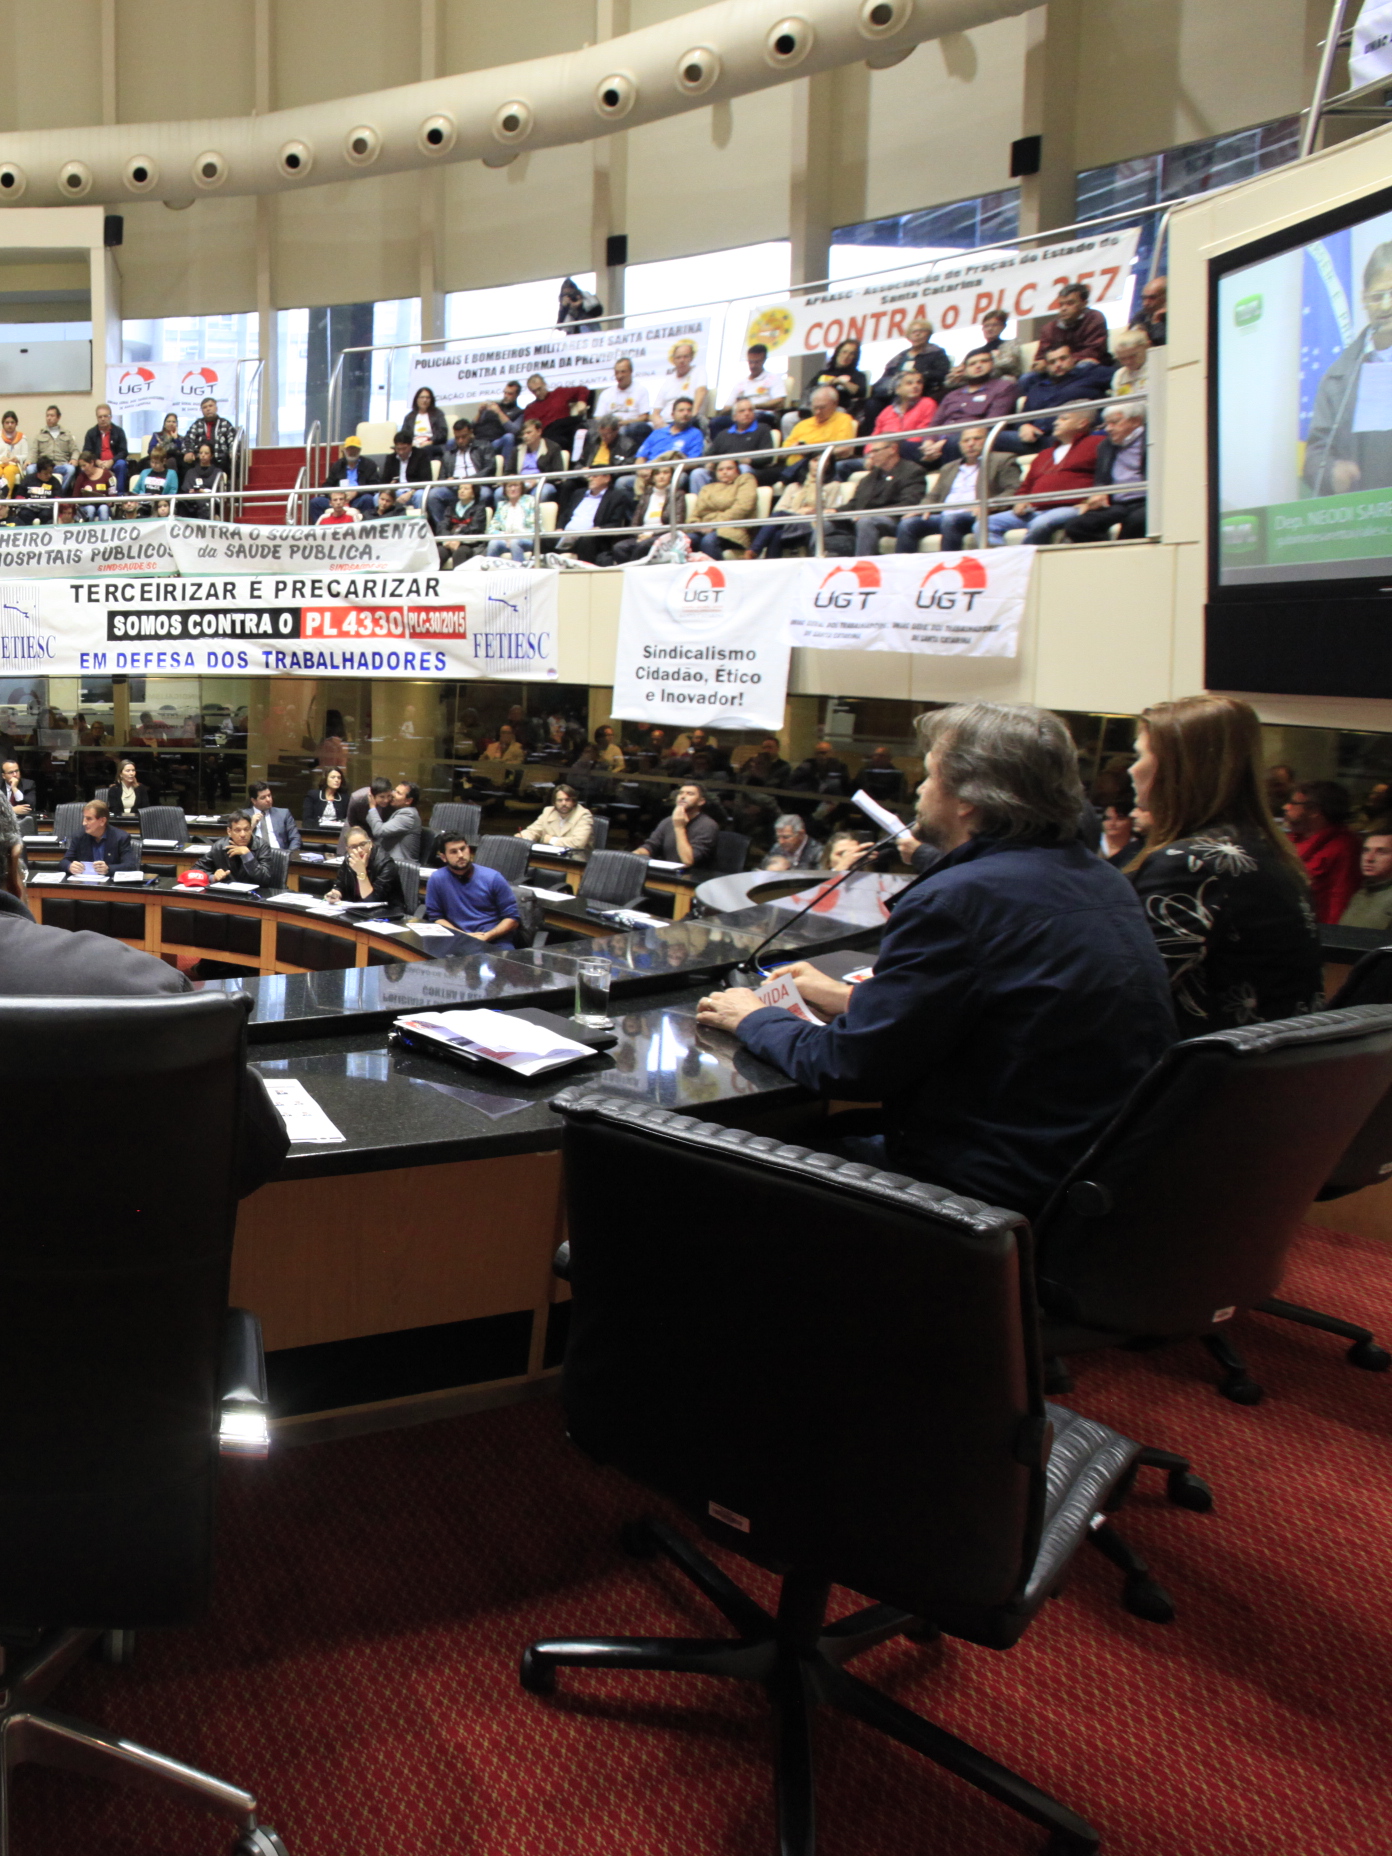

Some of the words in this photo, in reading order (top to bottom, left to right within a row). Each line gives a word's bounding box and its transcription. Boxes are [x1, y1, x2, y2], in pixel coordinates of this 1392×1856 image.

[803, 303, 928, 351] CONTRA
[414, 355, 463, 370] POLICIAIS
[471, 346, 532, 363] BOMBEIROS
[607, 331, 643, 346] SANTA
[645, 321, 703, 341] CATARINA
[457, 365, 498, 380] CONTRA
[499, 365, 506, 376] A
[508, 358, 556, 375] REFORMA
[558, 355, 573, 368] DA
[118, 380, 154, 395] UGT
[180, 383, 218, 396] UGT
[62, 525, 141, 547] PÚBLICO
[168, 522, 244, 541] CONTRA
[249, 527, 261, 542] O
[265, 520, 429, 543] SUCATEAMENTO
[196, 544, 218, 559] da
[224, 541, 282, 561] SAÚDE
[69, 581, 238, 604] TERCEIRIZAR
[248, 575, 264, 600] É
[273, 576, 442, 600] PRECARIZAR
[683, 589, 725, 603] UGT
[813, 589, 879, 611] UGT
[915, 588, 985, 612] UGT
[112, 614, 183, 637] SOMOS
[187, 612, 274, 636] CONTRA
[277, 612, 294, 636] O
[305, 610, 339, 637] PL
[341, 609, 405, 637] 4330
[472, 631, 551, 660] FETIESC
[642, 645, 757, 661] Sindicalismo
[79, 651, 108, 670] EM
[115, 651, 196, 670] DEFESA
[206, 650, 250, 670] DOS
[261, 650, 448, 672] TRABALHADORES
[635, 665, 709, 686] Cidadão,
[714, 664, 763, 685] Ético
[645, 690, 656, 702] e
[660, 688, 745, 707] Inovador!
